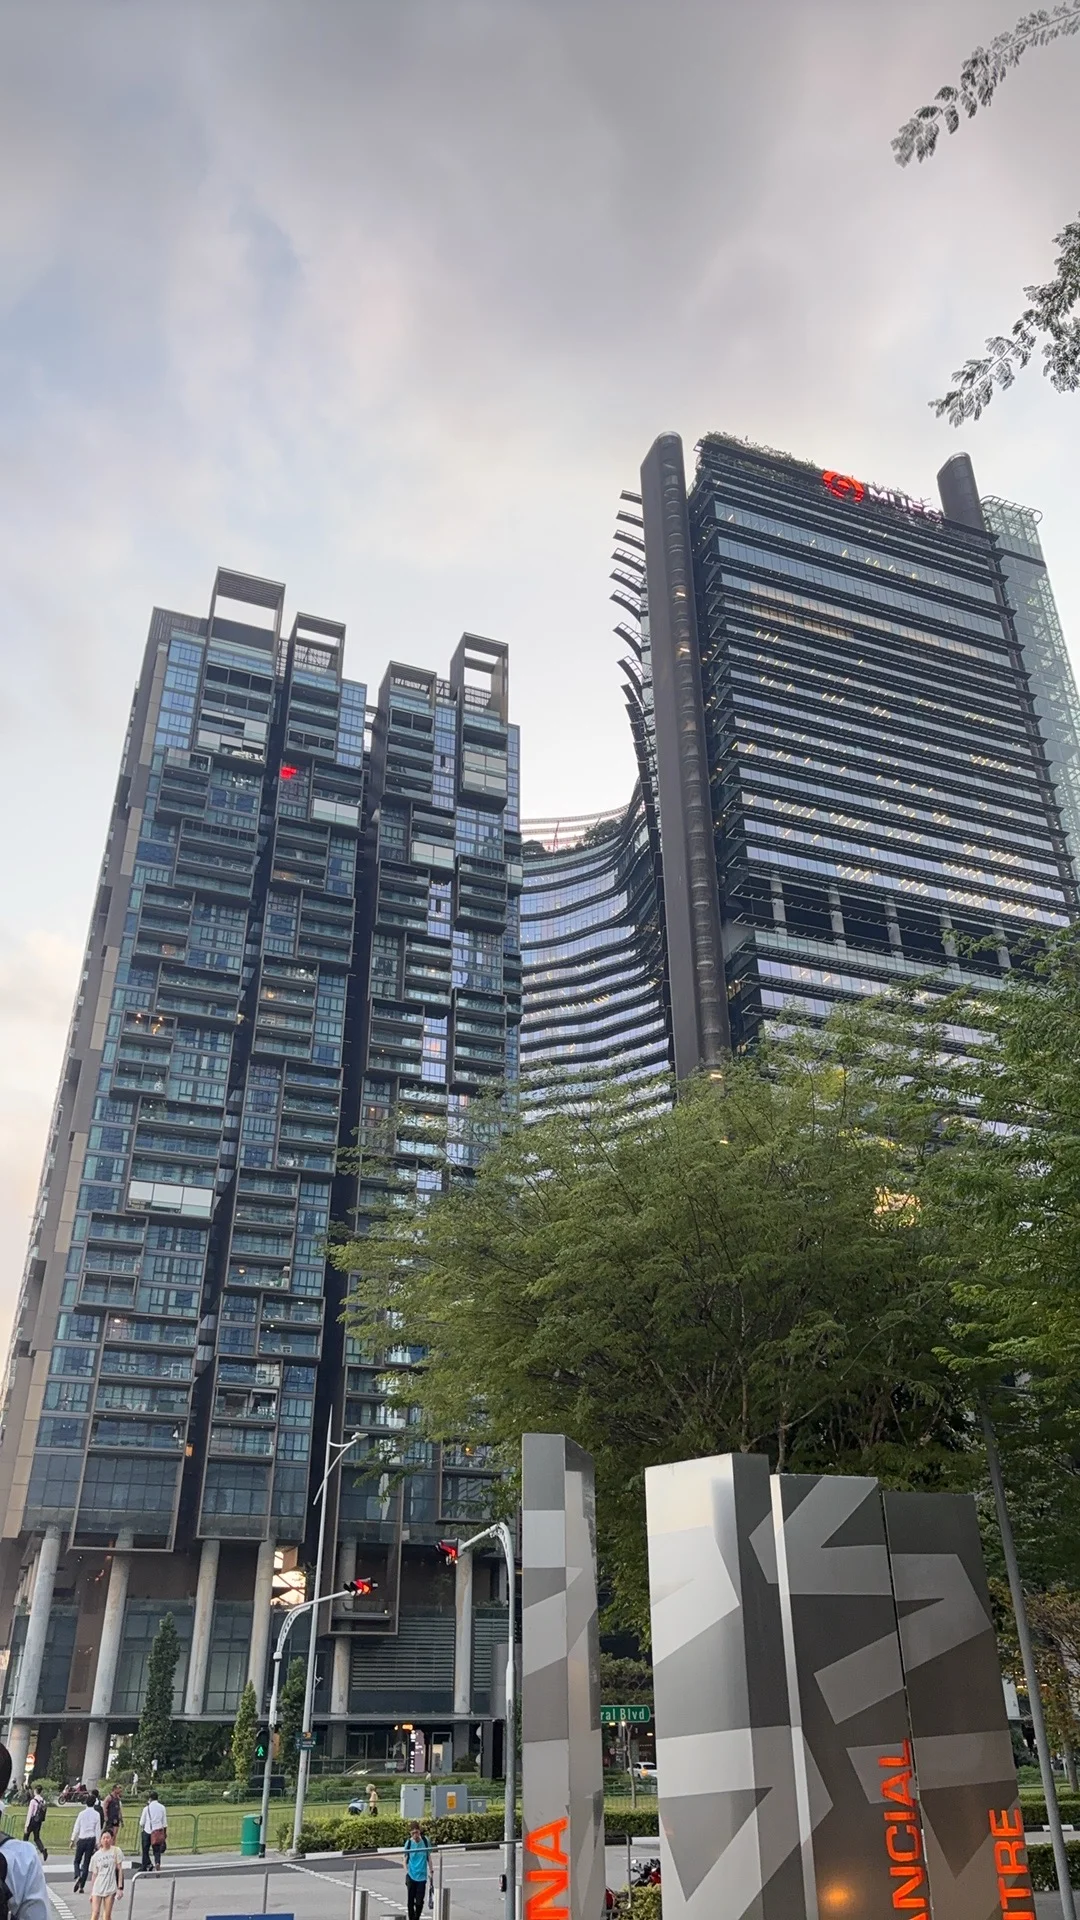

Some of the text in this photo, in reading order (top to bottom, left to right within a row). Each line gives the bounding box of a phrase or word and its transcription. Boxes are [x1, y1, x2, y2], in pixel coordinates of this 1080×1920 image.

[867, 486, 943, 523] MUFG
[620, 1708, 645, 1720] Blvd
[877, 1737, 930, 1920] NCIAL
[988, 1808, 1036, 1920] TRE
